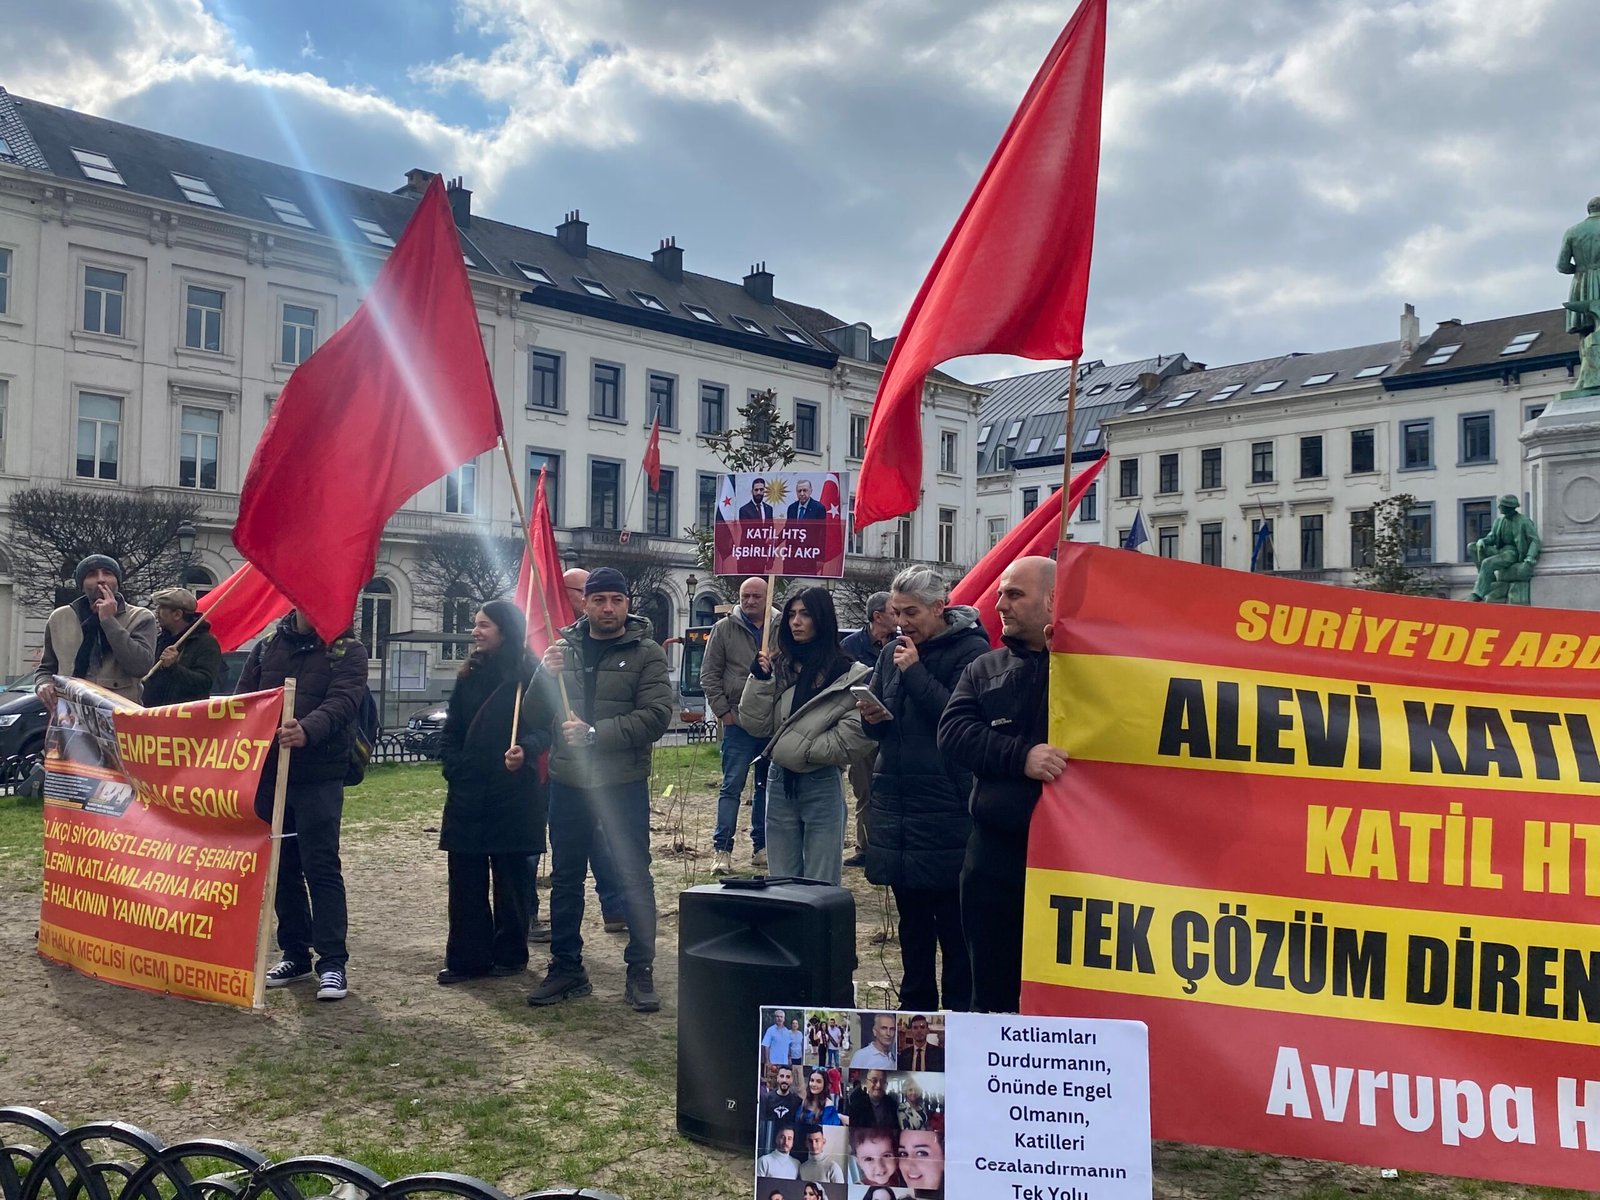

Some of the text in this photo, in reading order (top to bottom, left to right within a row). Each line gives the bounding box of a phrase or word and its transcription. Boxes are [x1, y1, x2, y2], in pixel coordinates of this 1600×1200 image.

[746, 526, 807, 543] KATİL HTŞ
[731, 544, 820, 560] İŞBİRLİKÇİ AKP
[1157, 677, 1382, 771] ALEVİ
[116, 730, 271, 772] EMPERYALİST
[189, 785, 244, 819] SON!
[43, 816, 258, 878] LİKÇİ SİYONİSTLERİN VE ŞERİATÇI
[1305, 802, 1504, 890] KATİL
[75, 857, 190, 898] KATLİAMLARINA
[188, 878, 239, 911] KARŞI
[51, 882, 109, 918] HALKININ
[112, 896, 214, 940] YANINDAYIZ!
[51, 930, 76, 956] HALK
[77, 943, 126, 971] MECLİSİ
[129, 953, 169, 985] (CEM)
[173, 963, 249, 998] DERNEĞİ
[1049, 894, 1600, 1024] TEK ÇÖZÜM DİREN
[1000, 1026, 1097, 1045] Katliamları
[987, 1051, 1111, 1076] Durdurmanın,
[987, 1075, 1113, 1102] Önünde Engel
[1265, 1046, 1600, 1152] Avrupa H
[1009, 1105, 1090, 1128] Olmanın,
[1014, 1132, 1085, 1151] Katilleri
[974, 1156, 1127, 1179] Cezalandırmanın
[1011, 1184, 1089, 1200] Tek Yolu
